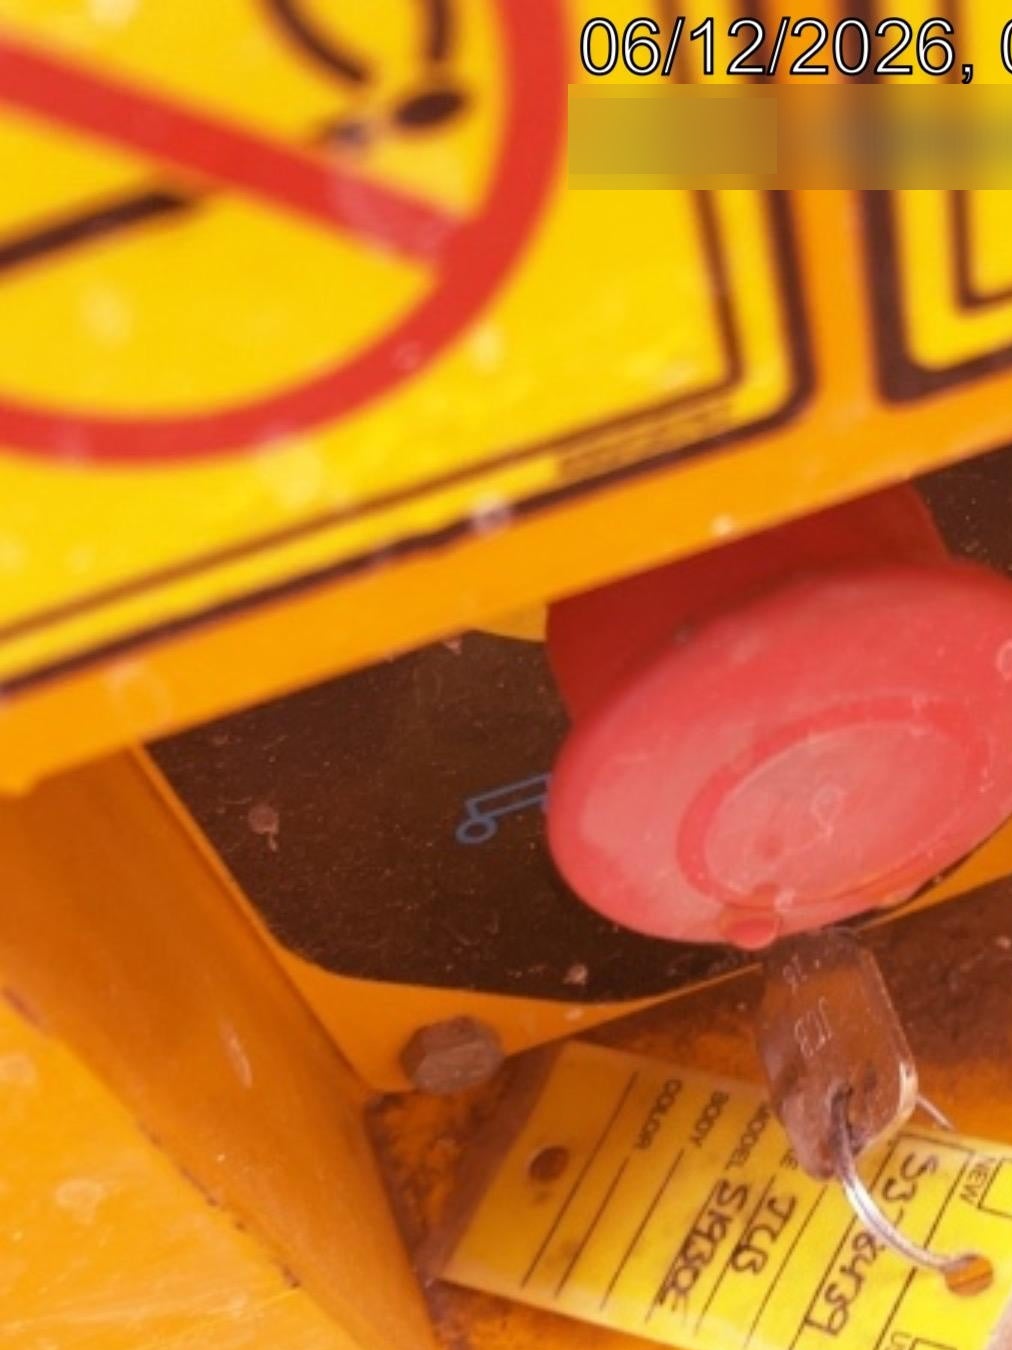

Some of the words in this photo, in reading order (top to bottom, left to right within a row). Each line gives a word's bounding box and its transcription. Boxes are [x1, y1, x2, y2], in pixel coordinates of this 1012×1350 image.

[634, 1078, 684, 1150] COLOR
[689, 1090, 732, 1148] BODY
[959, 1153, 996, 1206] NEW
[729, 1195, 799, 1276] JCB
